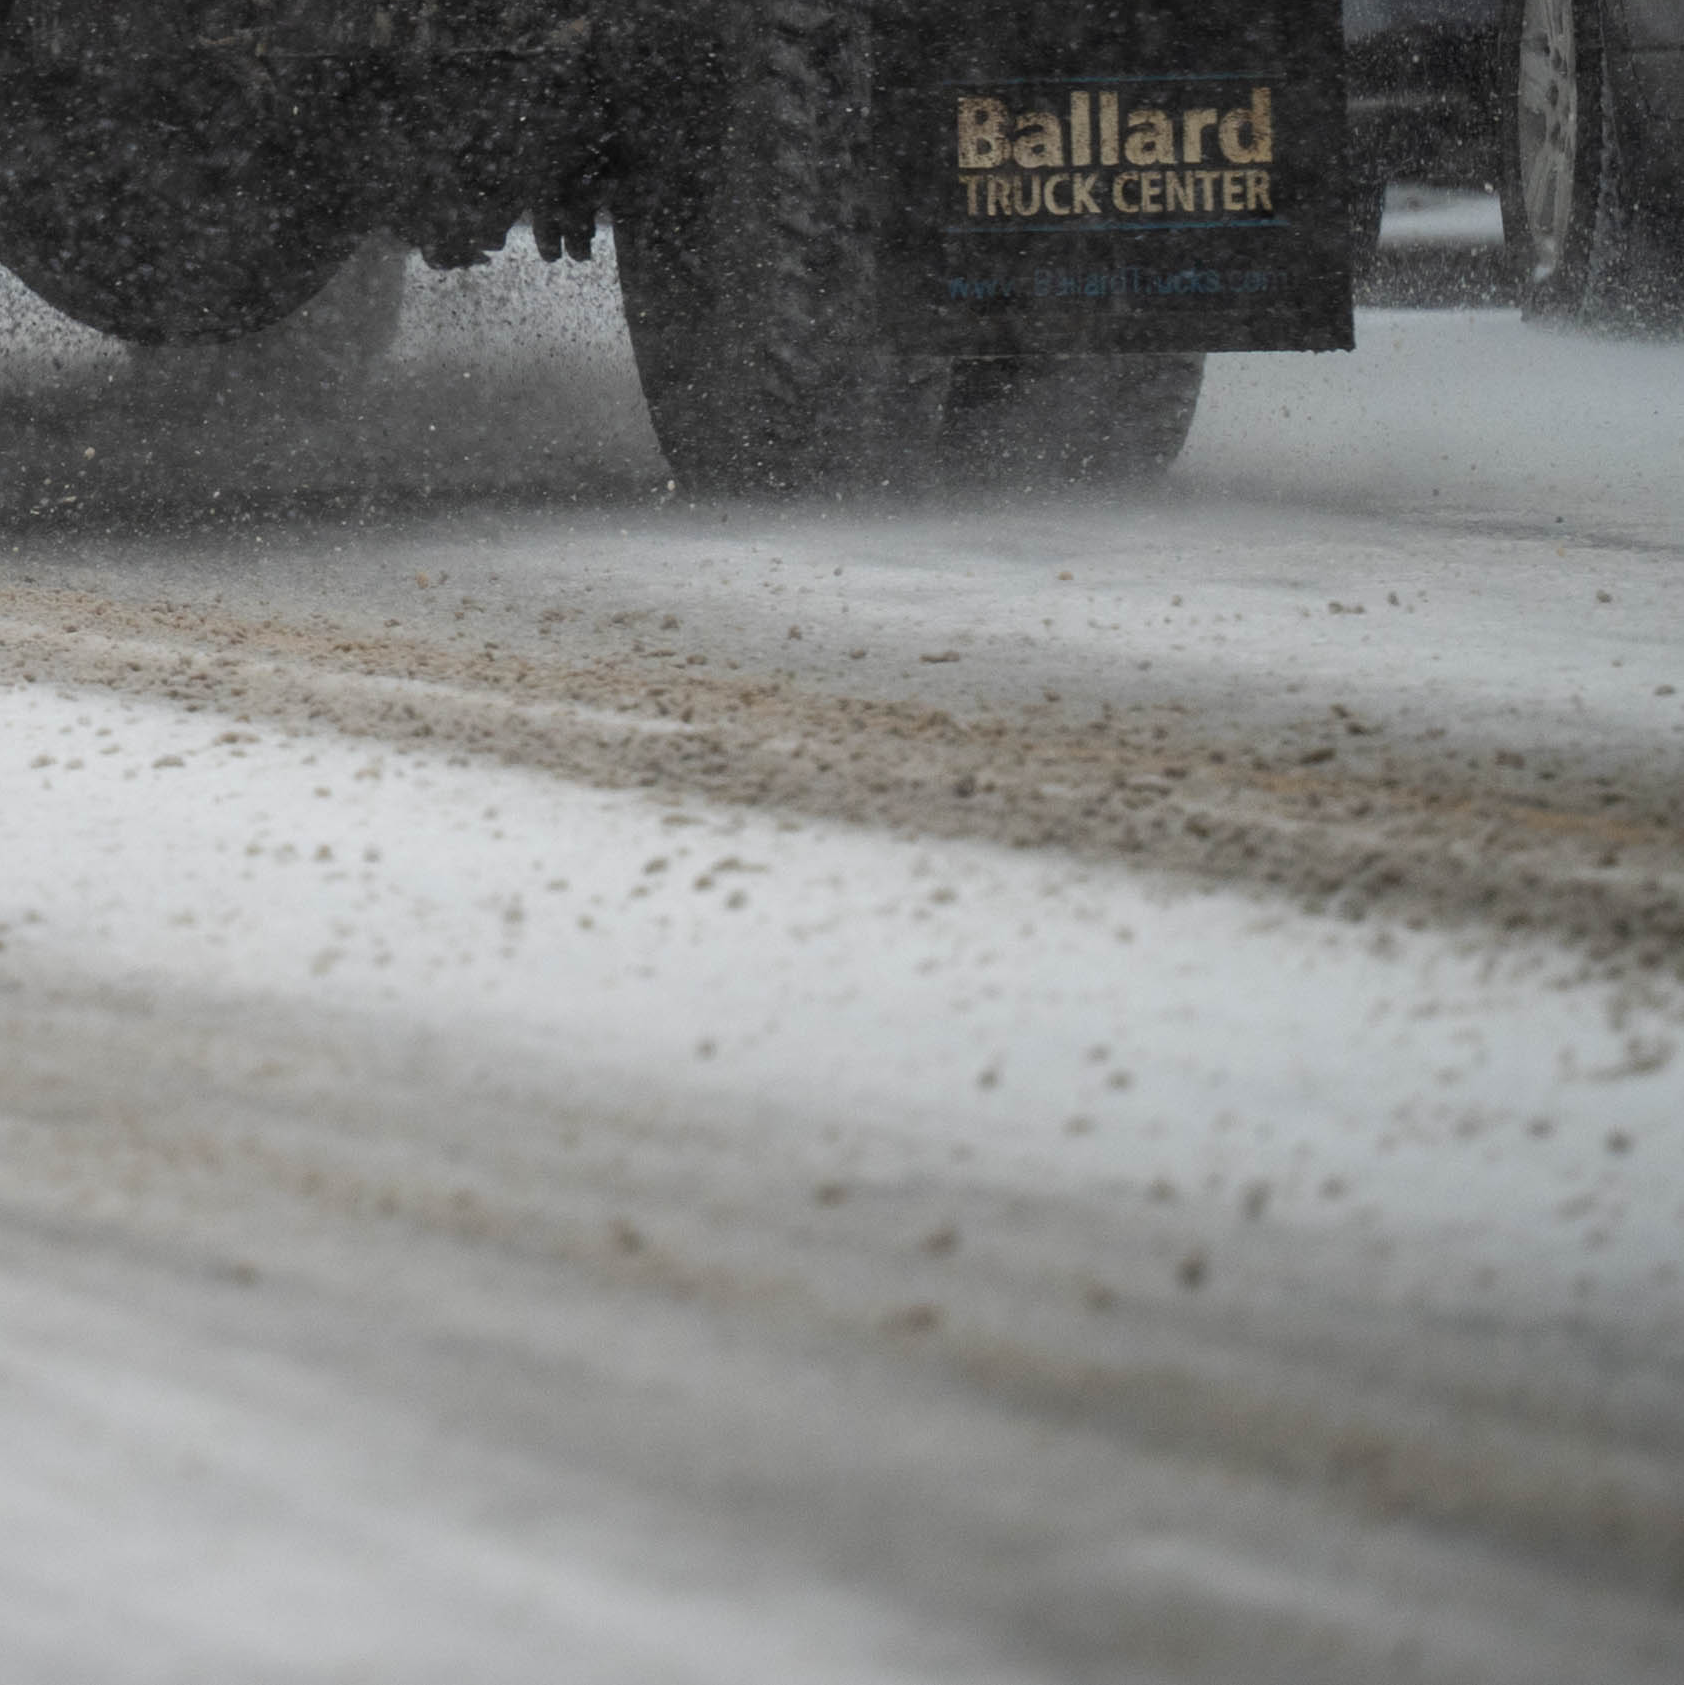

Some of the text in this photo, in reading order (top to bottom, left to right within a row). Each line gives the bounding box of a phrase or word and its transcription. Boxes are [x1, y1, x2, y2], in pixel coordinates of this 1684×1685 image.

[957, 87, 1273, 169] Ballard
[959, 169, 1274, 216] TRUCK CENTER
